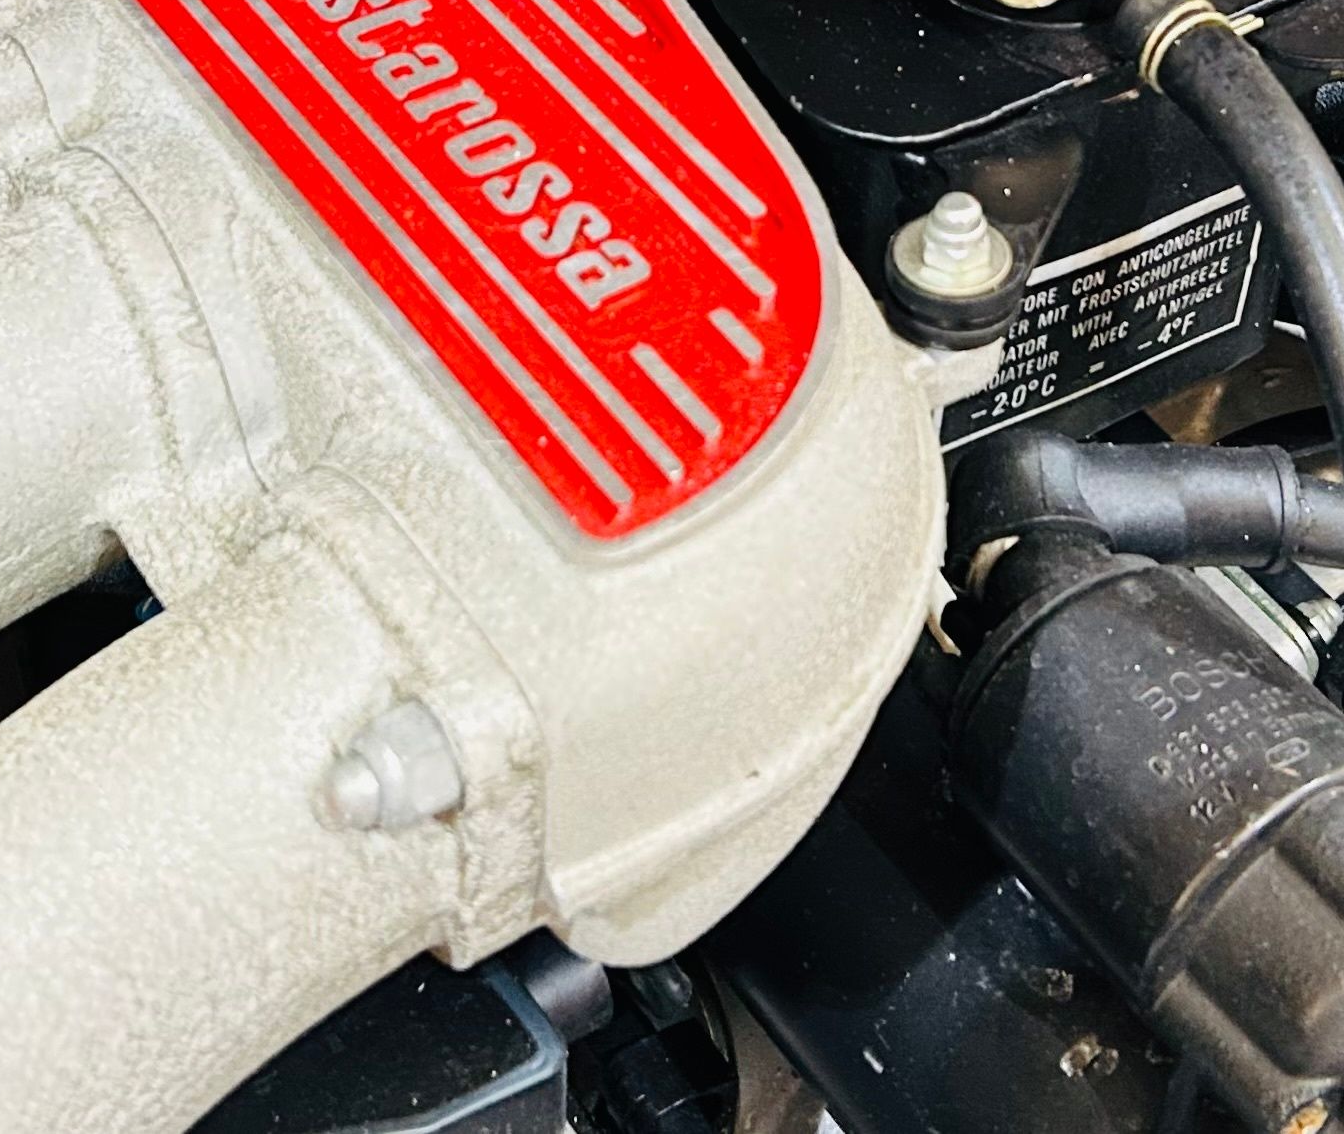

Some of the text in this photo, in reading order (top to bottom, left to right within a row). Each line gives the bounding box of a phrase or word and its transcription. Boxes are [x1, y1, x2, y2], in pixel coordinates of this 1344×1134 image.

[1019, 205, 1251, 313] ORE CON ANTICONGELANTE
[1037, 304, 1070, 330] MIT
[1078, 229, 1244, 314] FROSTSCHUTZMITTEL
[1071, 310, 1113, 339] WITH
[1133, 256, 1231, 313] ANTIFREEZE
[1088, 320, 1130, 352] AVEC
[1157, 280, 1224, 322] ANTIGEL
[1133, 650, 1267, 722] BOSCH
